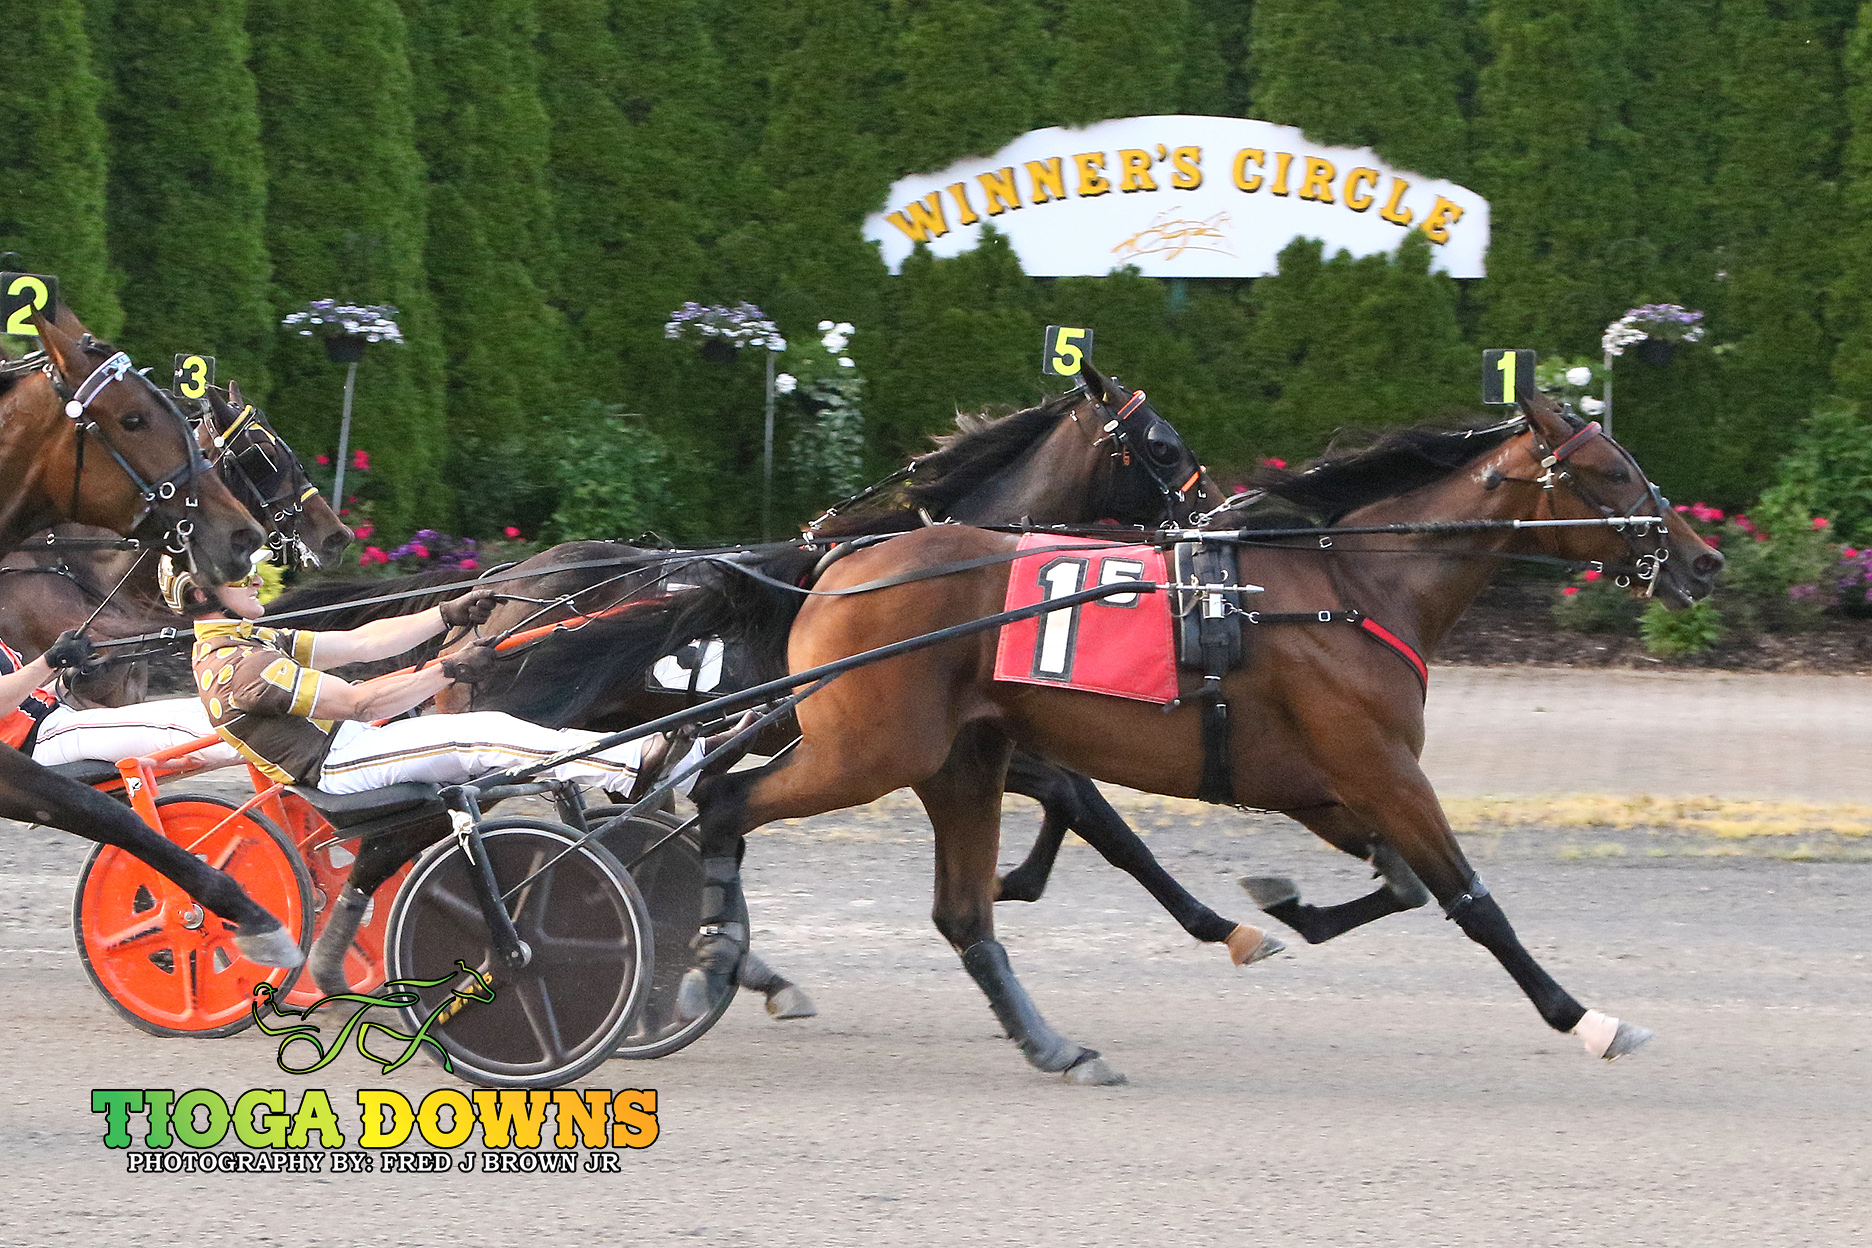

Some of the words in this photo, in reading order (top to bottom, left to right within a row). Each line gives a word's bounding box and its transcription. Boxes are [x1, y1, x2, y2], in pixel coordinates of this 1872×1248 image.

[885, 143, 1202, 242] WINNER'S
[1232, 148, 1464, 245] CIRCLE
[7, 276, 48, 335] 2
[180, 356, 208, 398] 3
[1052, 327, 1085, 376] 5
[1497, 351, 1516, 403] 1
